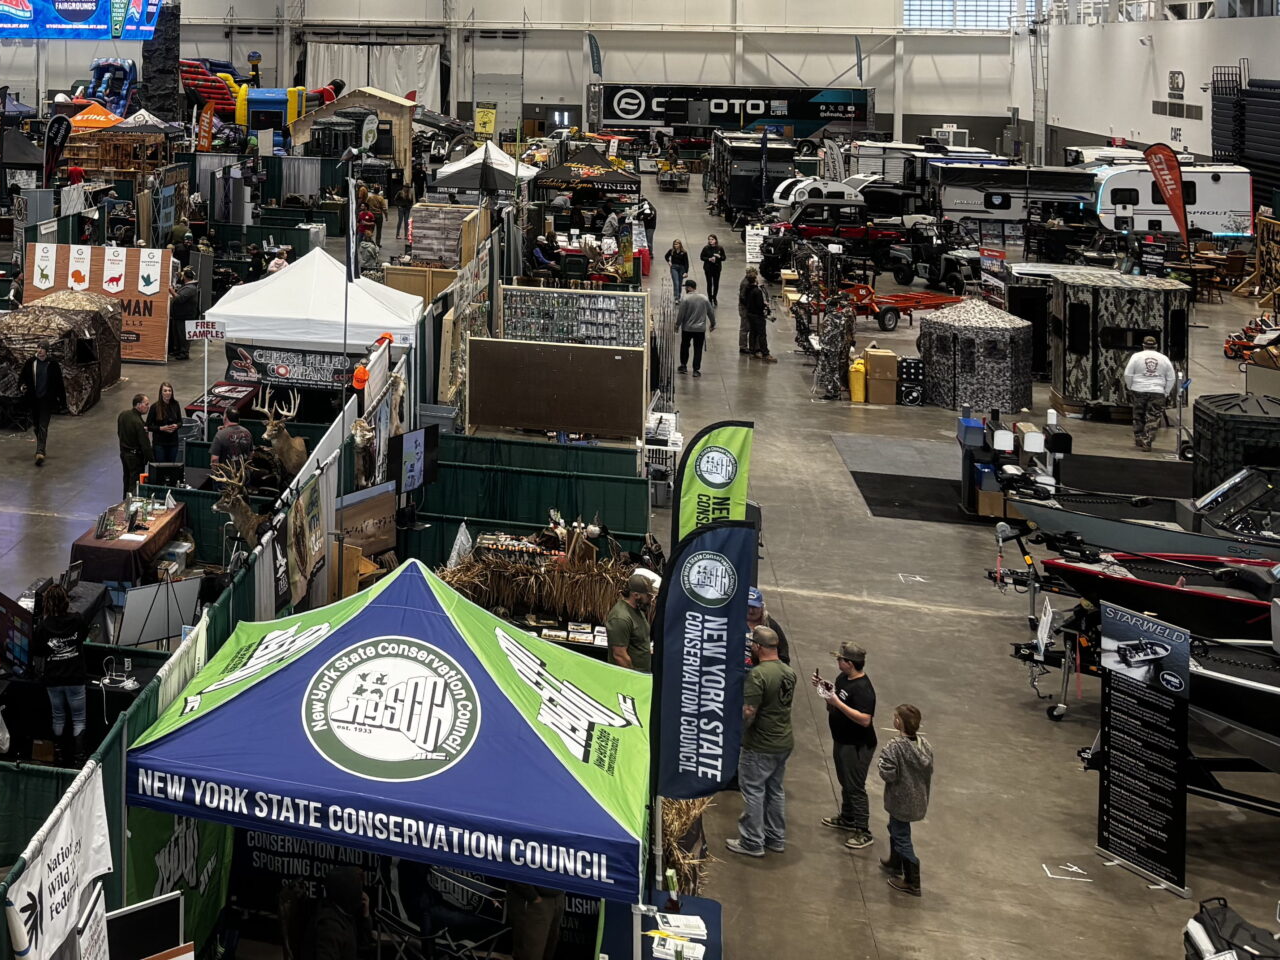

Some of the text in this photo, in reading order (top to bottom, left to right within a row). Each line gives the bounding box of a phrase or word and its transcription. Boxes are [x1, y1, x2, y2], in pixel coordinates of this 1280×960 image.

[55, 2, 96, 11] FAIRGROUNDS
[74, 114, 108, 122] STIHL
[652, 98, 765, 115] COTO
[199, 110, 211, 148] STIHL
[1170, 126, 1182, 143] CAFE
[569, 178, 593, 190] Lynn
[593, 182, 638, 191] WINERY
[1152, 153, 1177, 196] STIHL
[187, 330, 225, 340] SAMPLES
[195, 321, 216, 330] FREE
[253, 349, 351, 370] CHEESE FILLED
[1105, 607, 1185, 644] STARWELD
[333, 645, 376, 672] State
[377, 642, 467, 700] Conservation
[311, 666, 341, 700] York
[678, 611, 703, 774] CONSERVATION COUNCIL
[698, 615, 729, 783] NEW YORK STATE
[311, 699, 328, 732] New
[336, 724, 373, 735] est. 1933
[442, 700, 473, 755] Council
[137, 767, 186, 802] NEW
[191, 780, 248, 816] YORK
[254, 792, 323, 829] STATE
[328, 804, 504, 864] CONSERVATION
[509, 839, 616, 885] COUNCIL
[246, 830, 336, 860] CONSERVATION
[338, 845, 365, 865] AND
[252, 851, 312, 877] SPORTING
[48, 867, 70, 898] Wild
